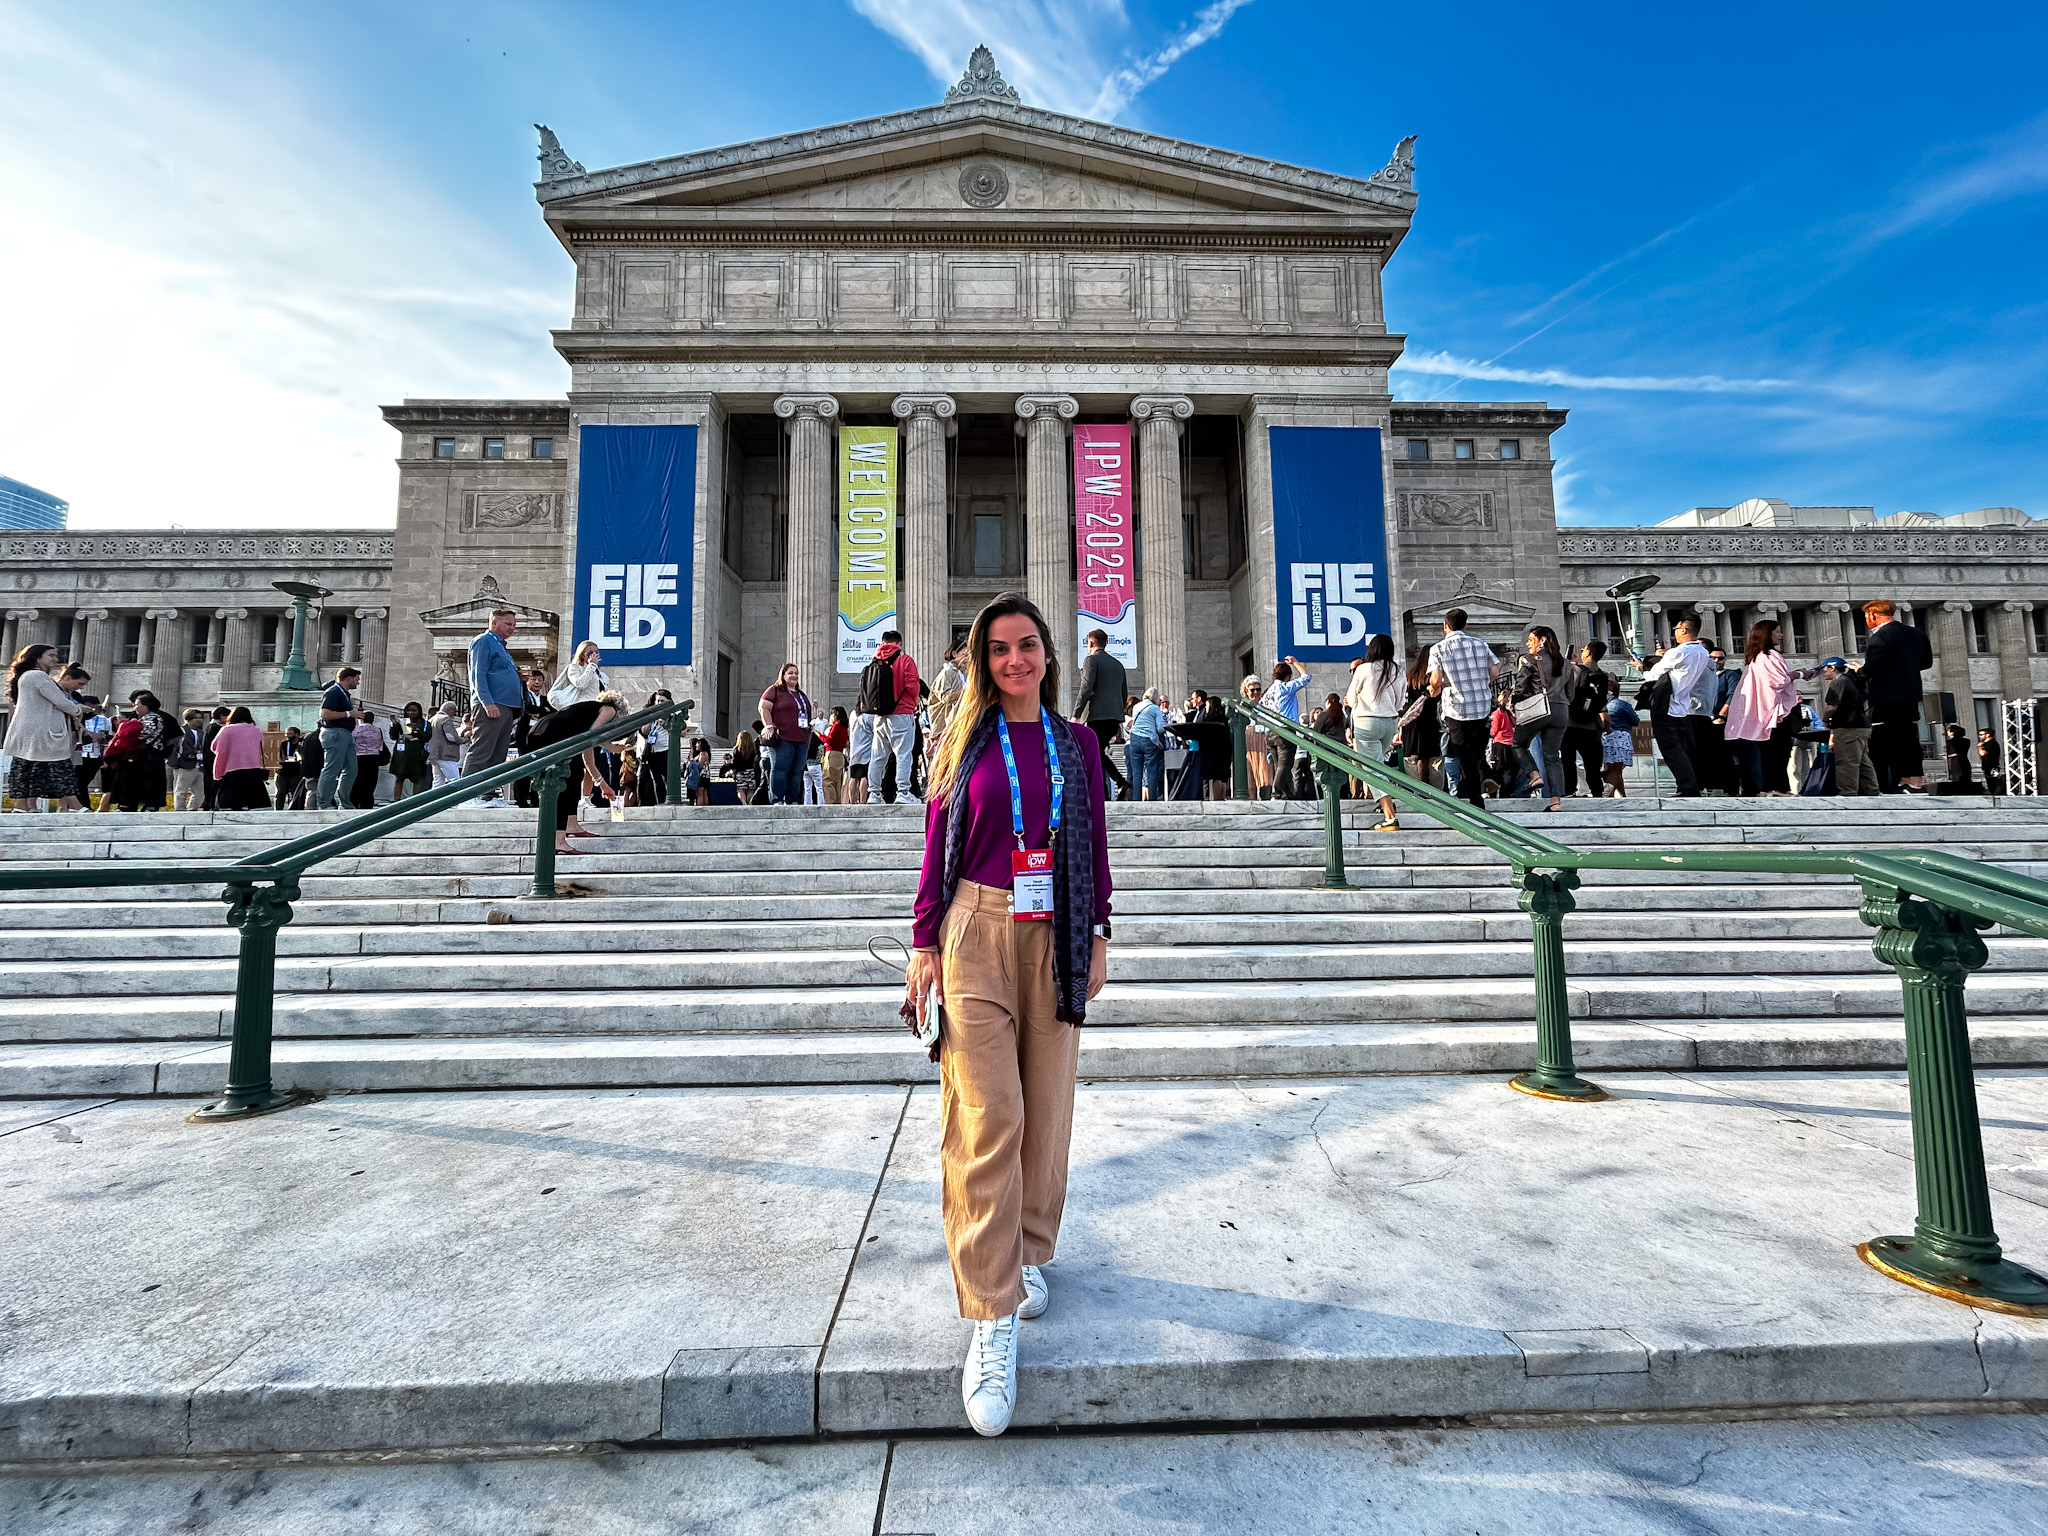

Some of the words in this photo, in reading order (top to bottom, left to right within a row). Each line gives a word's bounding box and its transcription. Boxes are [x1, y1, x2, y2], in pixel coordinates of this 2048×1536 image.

[1084, 442, 1122, 496] IPW
[848, 441, 887, 593] WELCOME
[1085, 513, 1124, 588] 2025
[610, 594, 620, 632] MUSEUM
[1312, 592, 1322, 629] MUSEUM
